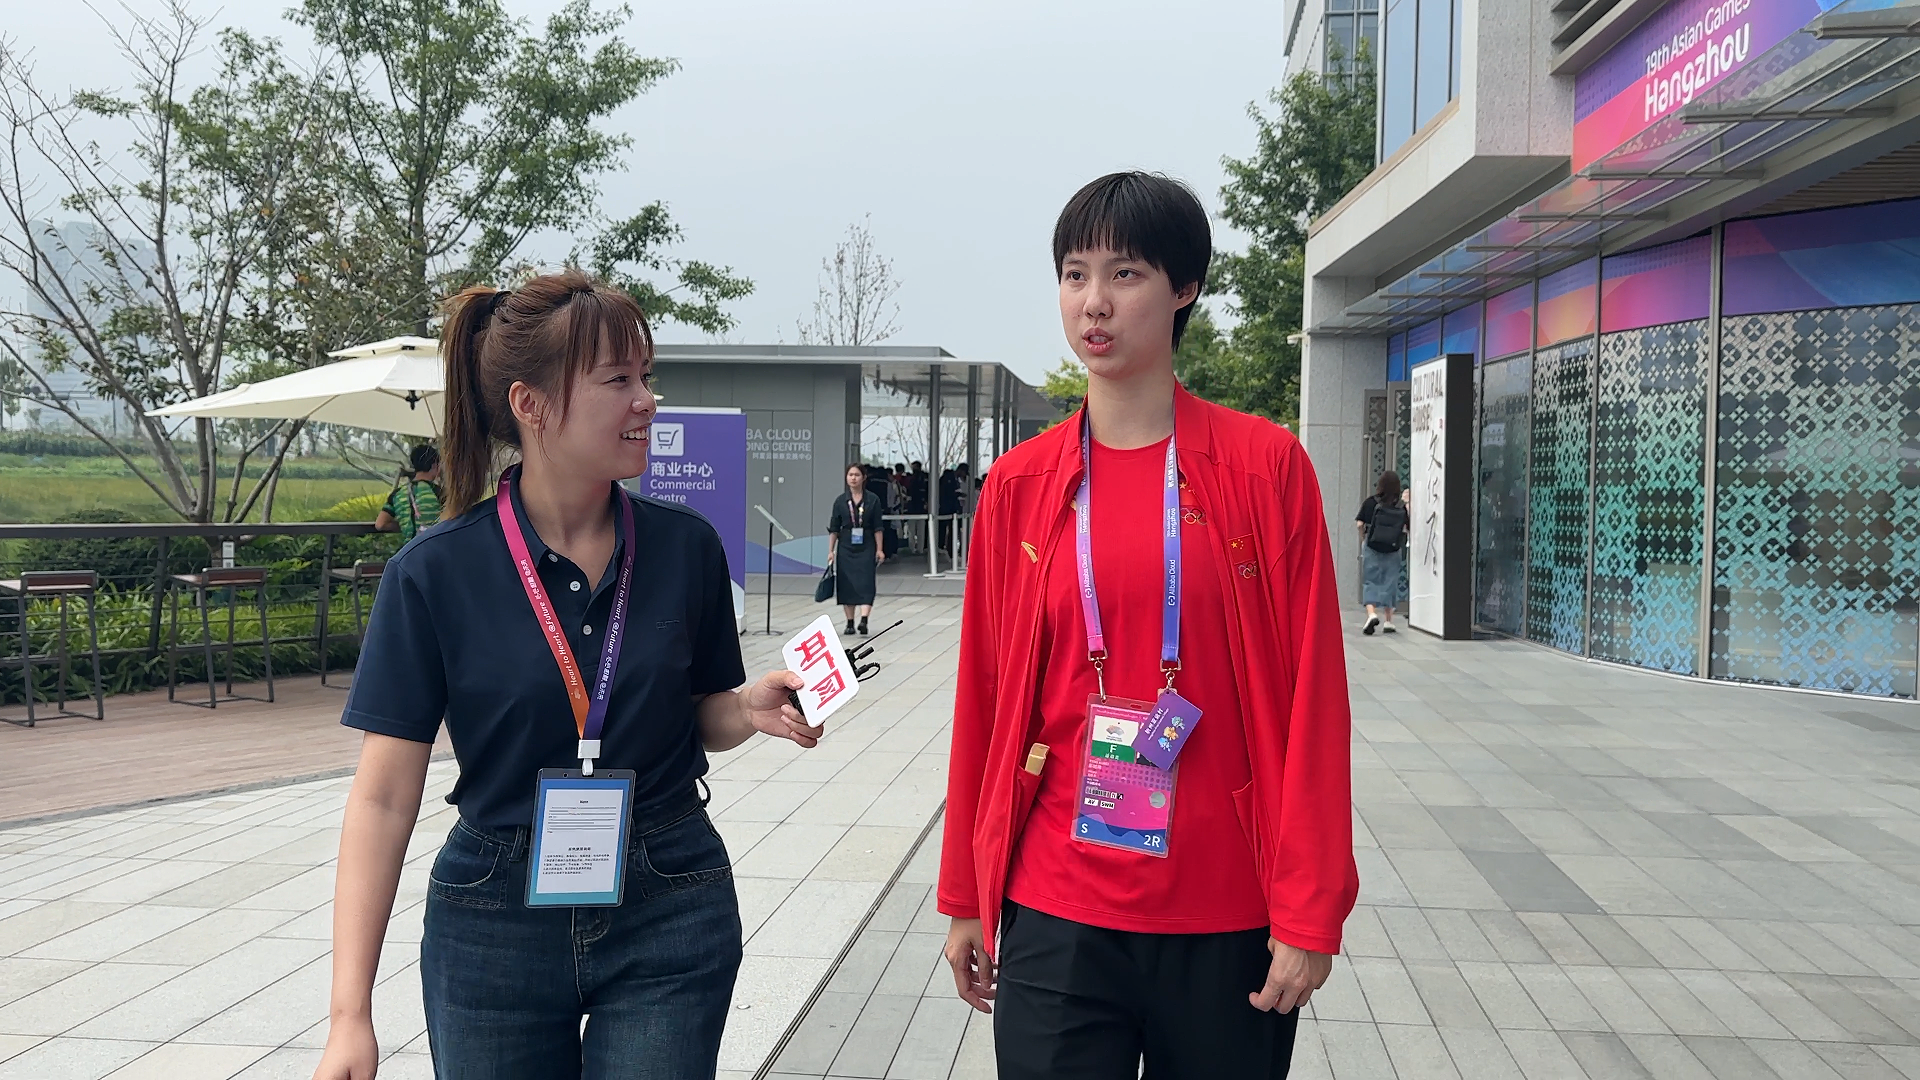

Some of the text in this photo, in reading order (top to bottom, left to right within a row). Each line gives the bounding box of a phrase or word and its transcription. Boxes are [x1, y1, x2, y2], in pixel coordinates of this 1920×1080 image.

[1645, 0, 1750, 79] 19th Asian Games
[1644, 22, 1750, 122] Hangzhou
[766, 428, 812, 441] CLOUD
[772, 442, 812, 452] CENTRE
[650, 461, 714, 478] 商业中心
[650, 478, 716, 491] Commercial
[621, 567, 630, 590] Heart
[1083, 568, 1091, 587] Alibaba
[1168, 559, 1176, 595] Alibaba Cloud
[539, 601, 556, 632] @Future
[613, 597, 624, 621] Heart,
[552, 632, 566, 655] Heart,
[607, 621, 620, 654] @Future
[565, 665, 578, 686] Heart
[1110, 744, 1118, 753] F
[1081, 823, 1161, 847] S 2R
